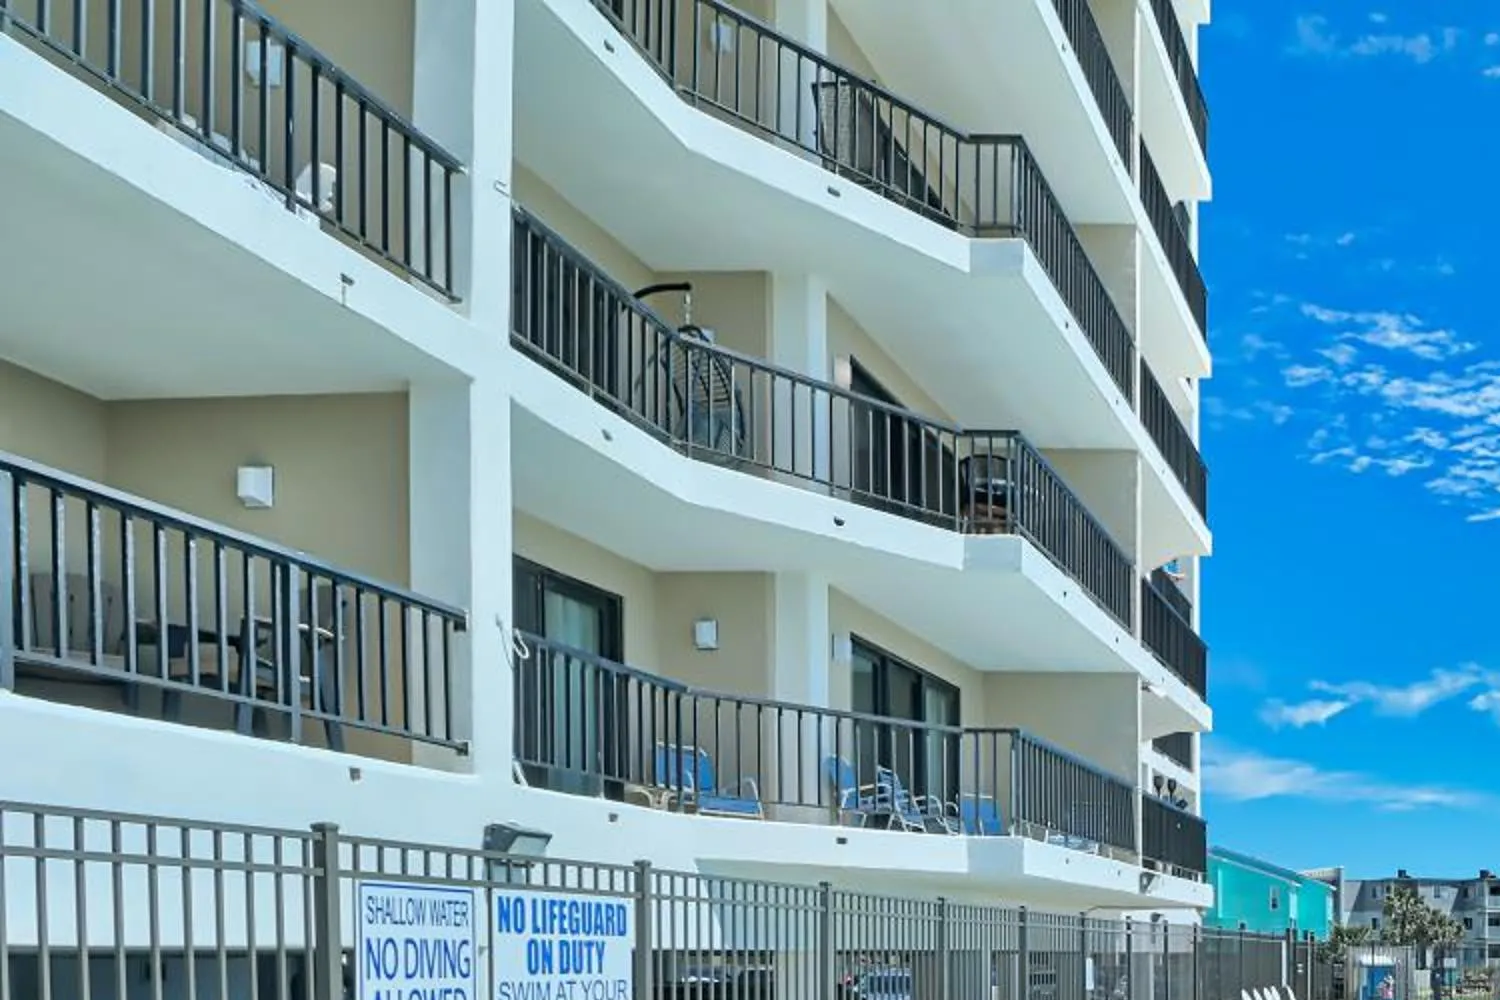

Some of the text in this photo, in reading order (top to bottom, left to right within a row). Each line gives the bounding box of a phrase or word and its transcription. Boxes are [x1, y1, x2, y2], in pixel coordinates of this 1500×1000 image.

[367, 896, 469, 927] SHALLOW WATER
[498, 896, 627, 936] NO LIFEGUARD
[366, 938, 471, 980] NO DIVING
[527, 939, 606, 975] ON DUTY
